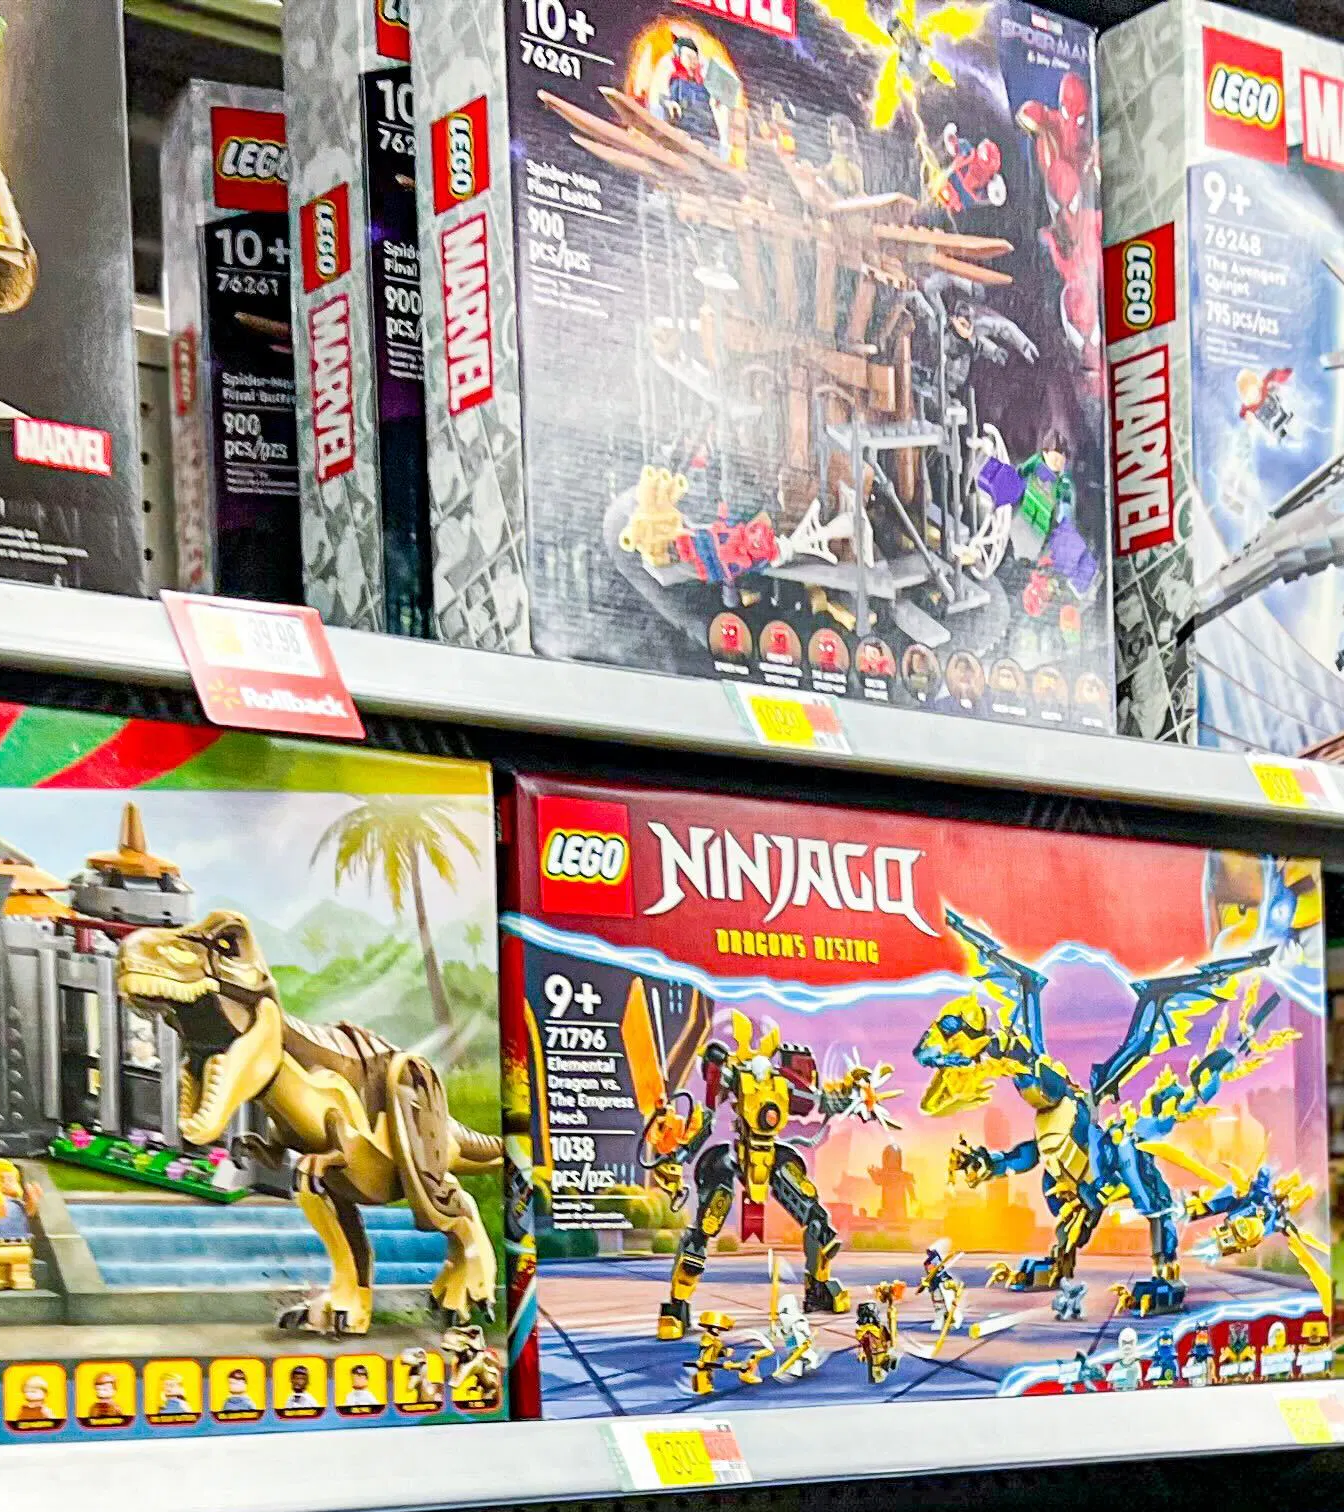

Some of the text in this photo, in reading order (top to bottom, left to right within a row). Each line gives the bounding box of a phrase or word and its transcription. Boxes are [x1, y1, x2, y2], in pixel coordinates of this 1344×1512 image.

[521, 0, 594, 45] 10+
[520, 41, 581, 80] 76261
[1210, 68, 1279, 123] LEGO
[448, 116, 471, 197] LEGO
[1204, 172, 1251, 214] 9+
[314, 201, 337, 277] LEGO
[527, 209, 564, 240] 900
[1205, 224, 1262, 257] 76248
[216, 230, 290, 266] 10+
[529, 237, 591, 273] pcs/pzs
[216, 273, 279, 295] 76261
[1125, 246, 1152, 325] LEGO
[1205, 275, 1250, 297] Quinjet
[1206, 256, 1287, 287] The Avengers
[384, 285, 421, 312] 900
[444, 218, 490, 414] MARVEL
[1205, 301, 1279, 336] 795 pcs/pzs
[308, 297, 353, 480] MARVEL
[223, 413, 262, 437] 900
[17, 421, 109, 472] MARVEL
[223, 438, 288, 461] pcs/pzs
[1114, 353, 1172, 550] MARVEL
[241, 687, 348, 718] Rollback
[548, 821, 940, 938] LEGO NINJAGO
[716, 928, 879, 964] DRAGONS RISING
[544, 974, 602, 1018] 9+
[545, 1026, 607, 1050] 71796
[547, 1056, 616, 1074] Elemental
[548, 1075, 621, 1093] Dragon vs.
[549, 1092, 635, 1111] The Empress
[549, 1110, 588, 1126] Mech
[551, 1136, 595, 1162] 1038
[551, 1163, 615, 1193] pcs/pzs
